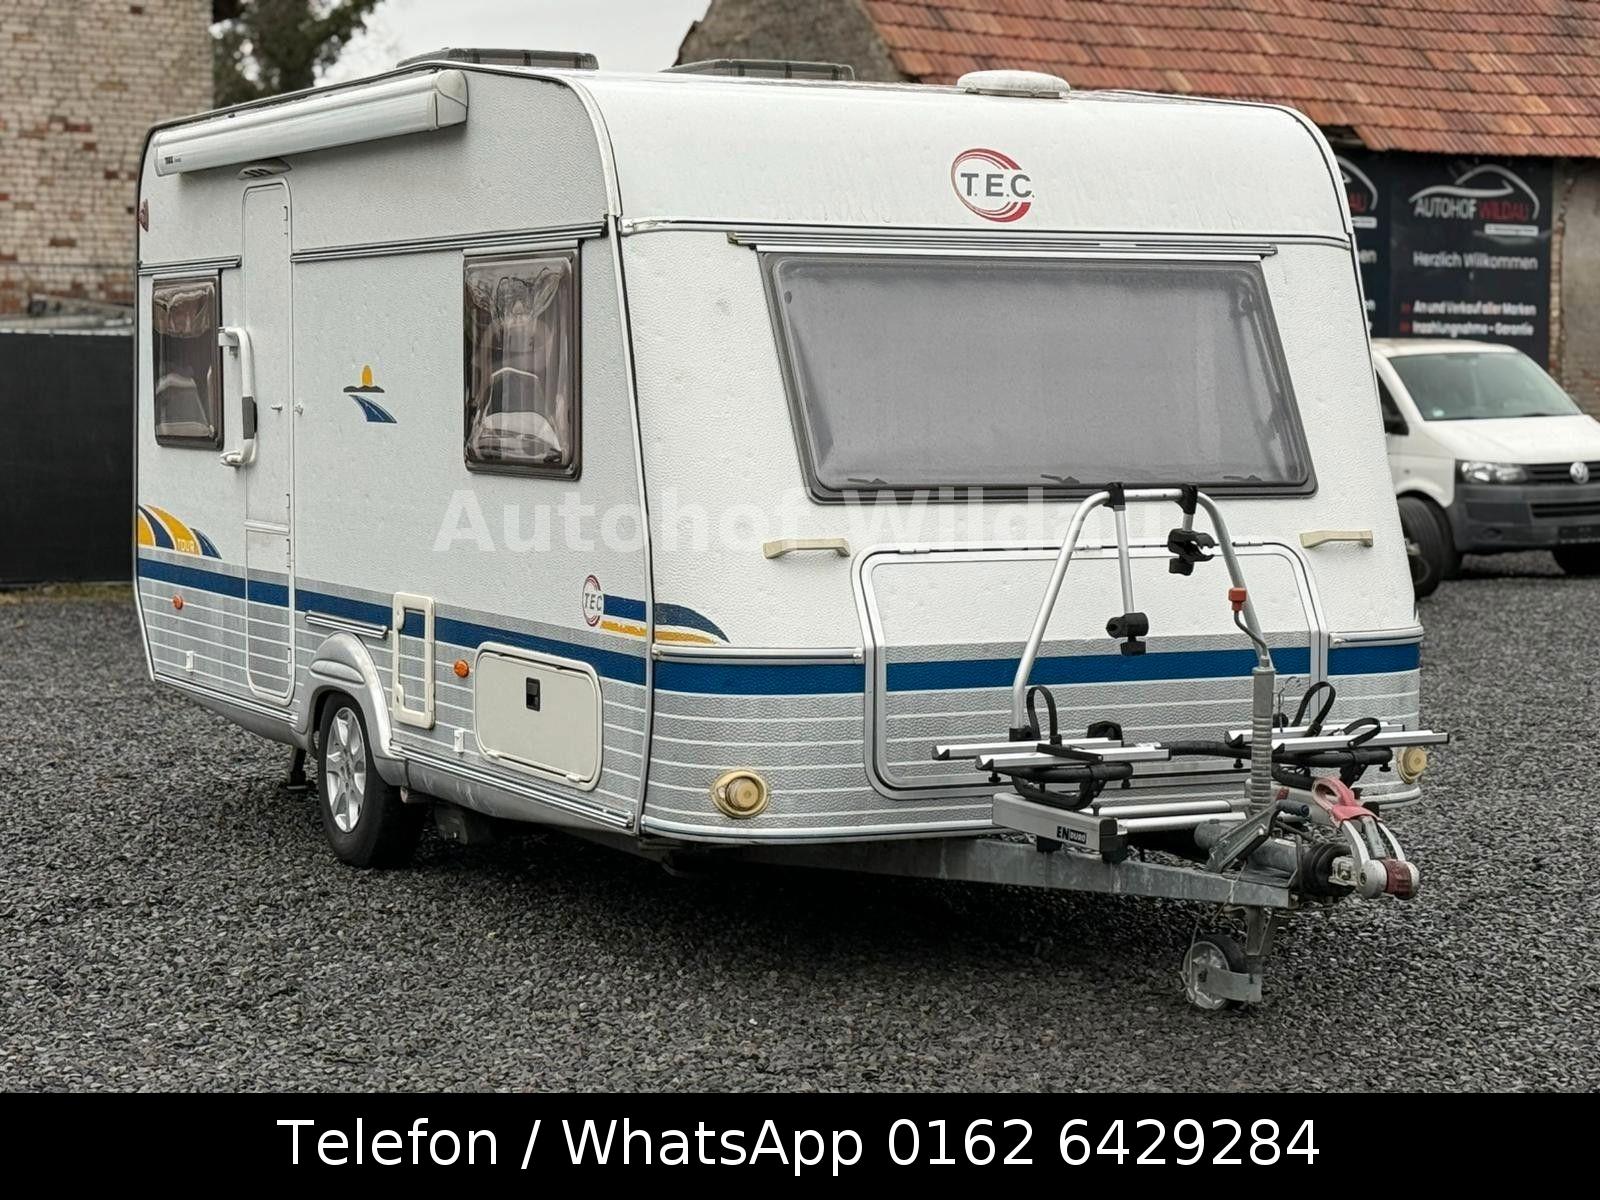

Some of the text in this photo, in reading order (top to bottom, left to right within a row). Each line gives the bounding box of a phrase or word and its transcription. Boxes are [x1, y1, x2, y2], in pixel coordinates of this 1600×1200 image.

[1414, 197, 1530, 221] AUTOHOF WILDAU
[1413, 251, 1538, 270] Herzlich Willkommen
